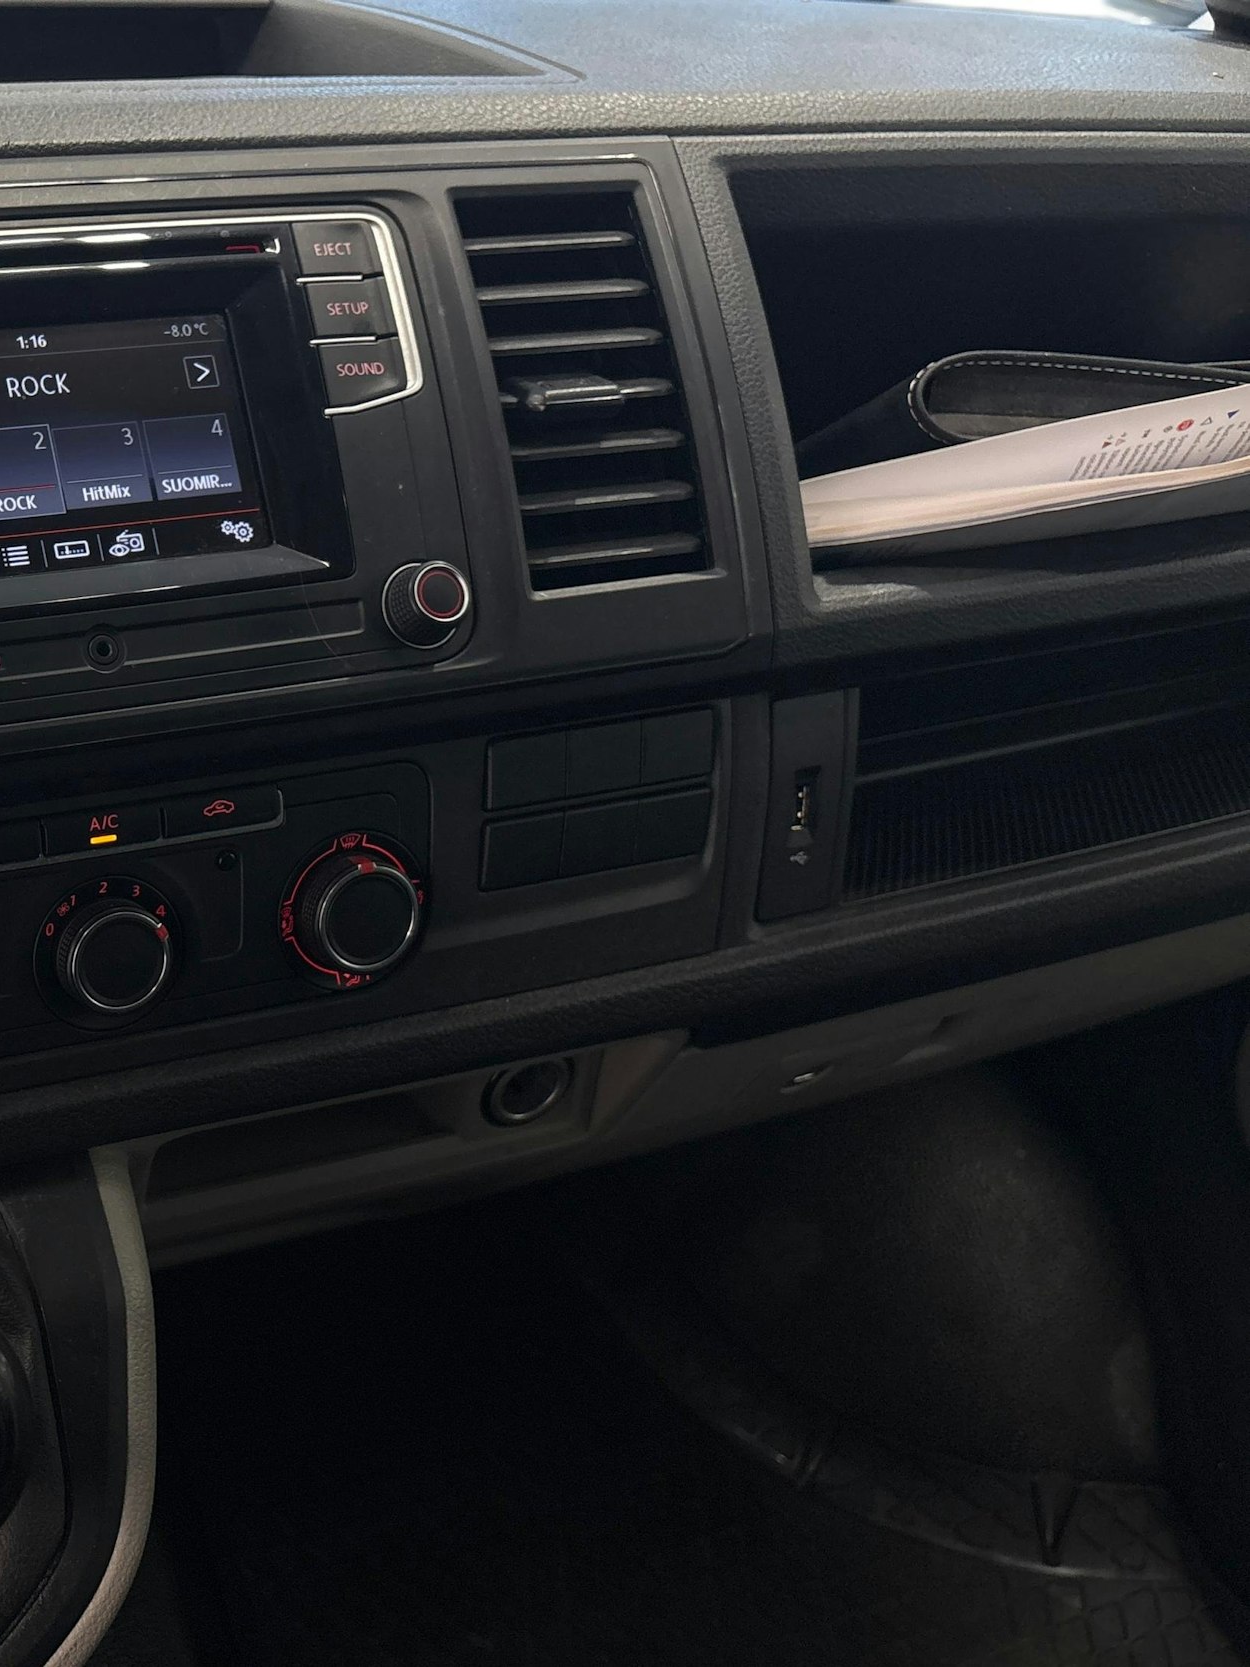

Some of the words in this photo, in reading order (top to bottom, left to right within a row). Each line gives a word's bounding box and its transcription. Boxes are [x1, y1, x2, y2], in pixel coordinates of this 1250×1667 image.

[314, 242, 351, 256] EJECT
[326, 302, 369, 316] SETUP
[16, 334, 47, 349] 1:16
[336, 362, 384, 377] SOUND
[6, 374, 70, 398] ROCK
[121, 428, 134, 446] 3
[211, 419, 223, 437] 4
[32, 431, 47, 450] 2
[82, 484, 131, 502] HitMix
[90, 814, 119, 832] A/C
[45, 922, 55, 937] 0
[99, 881, 109, 894] 2
[132, 884, 141, 897] 3
[155, 903, 167, 918] 4
